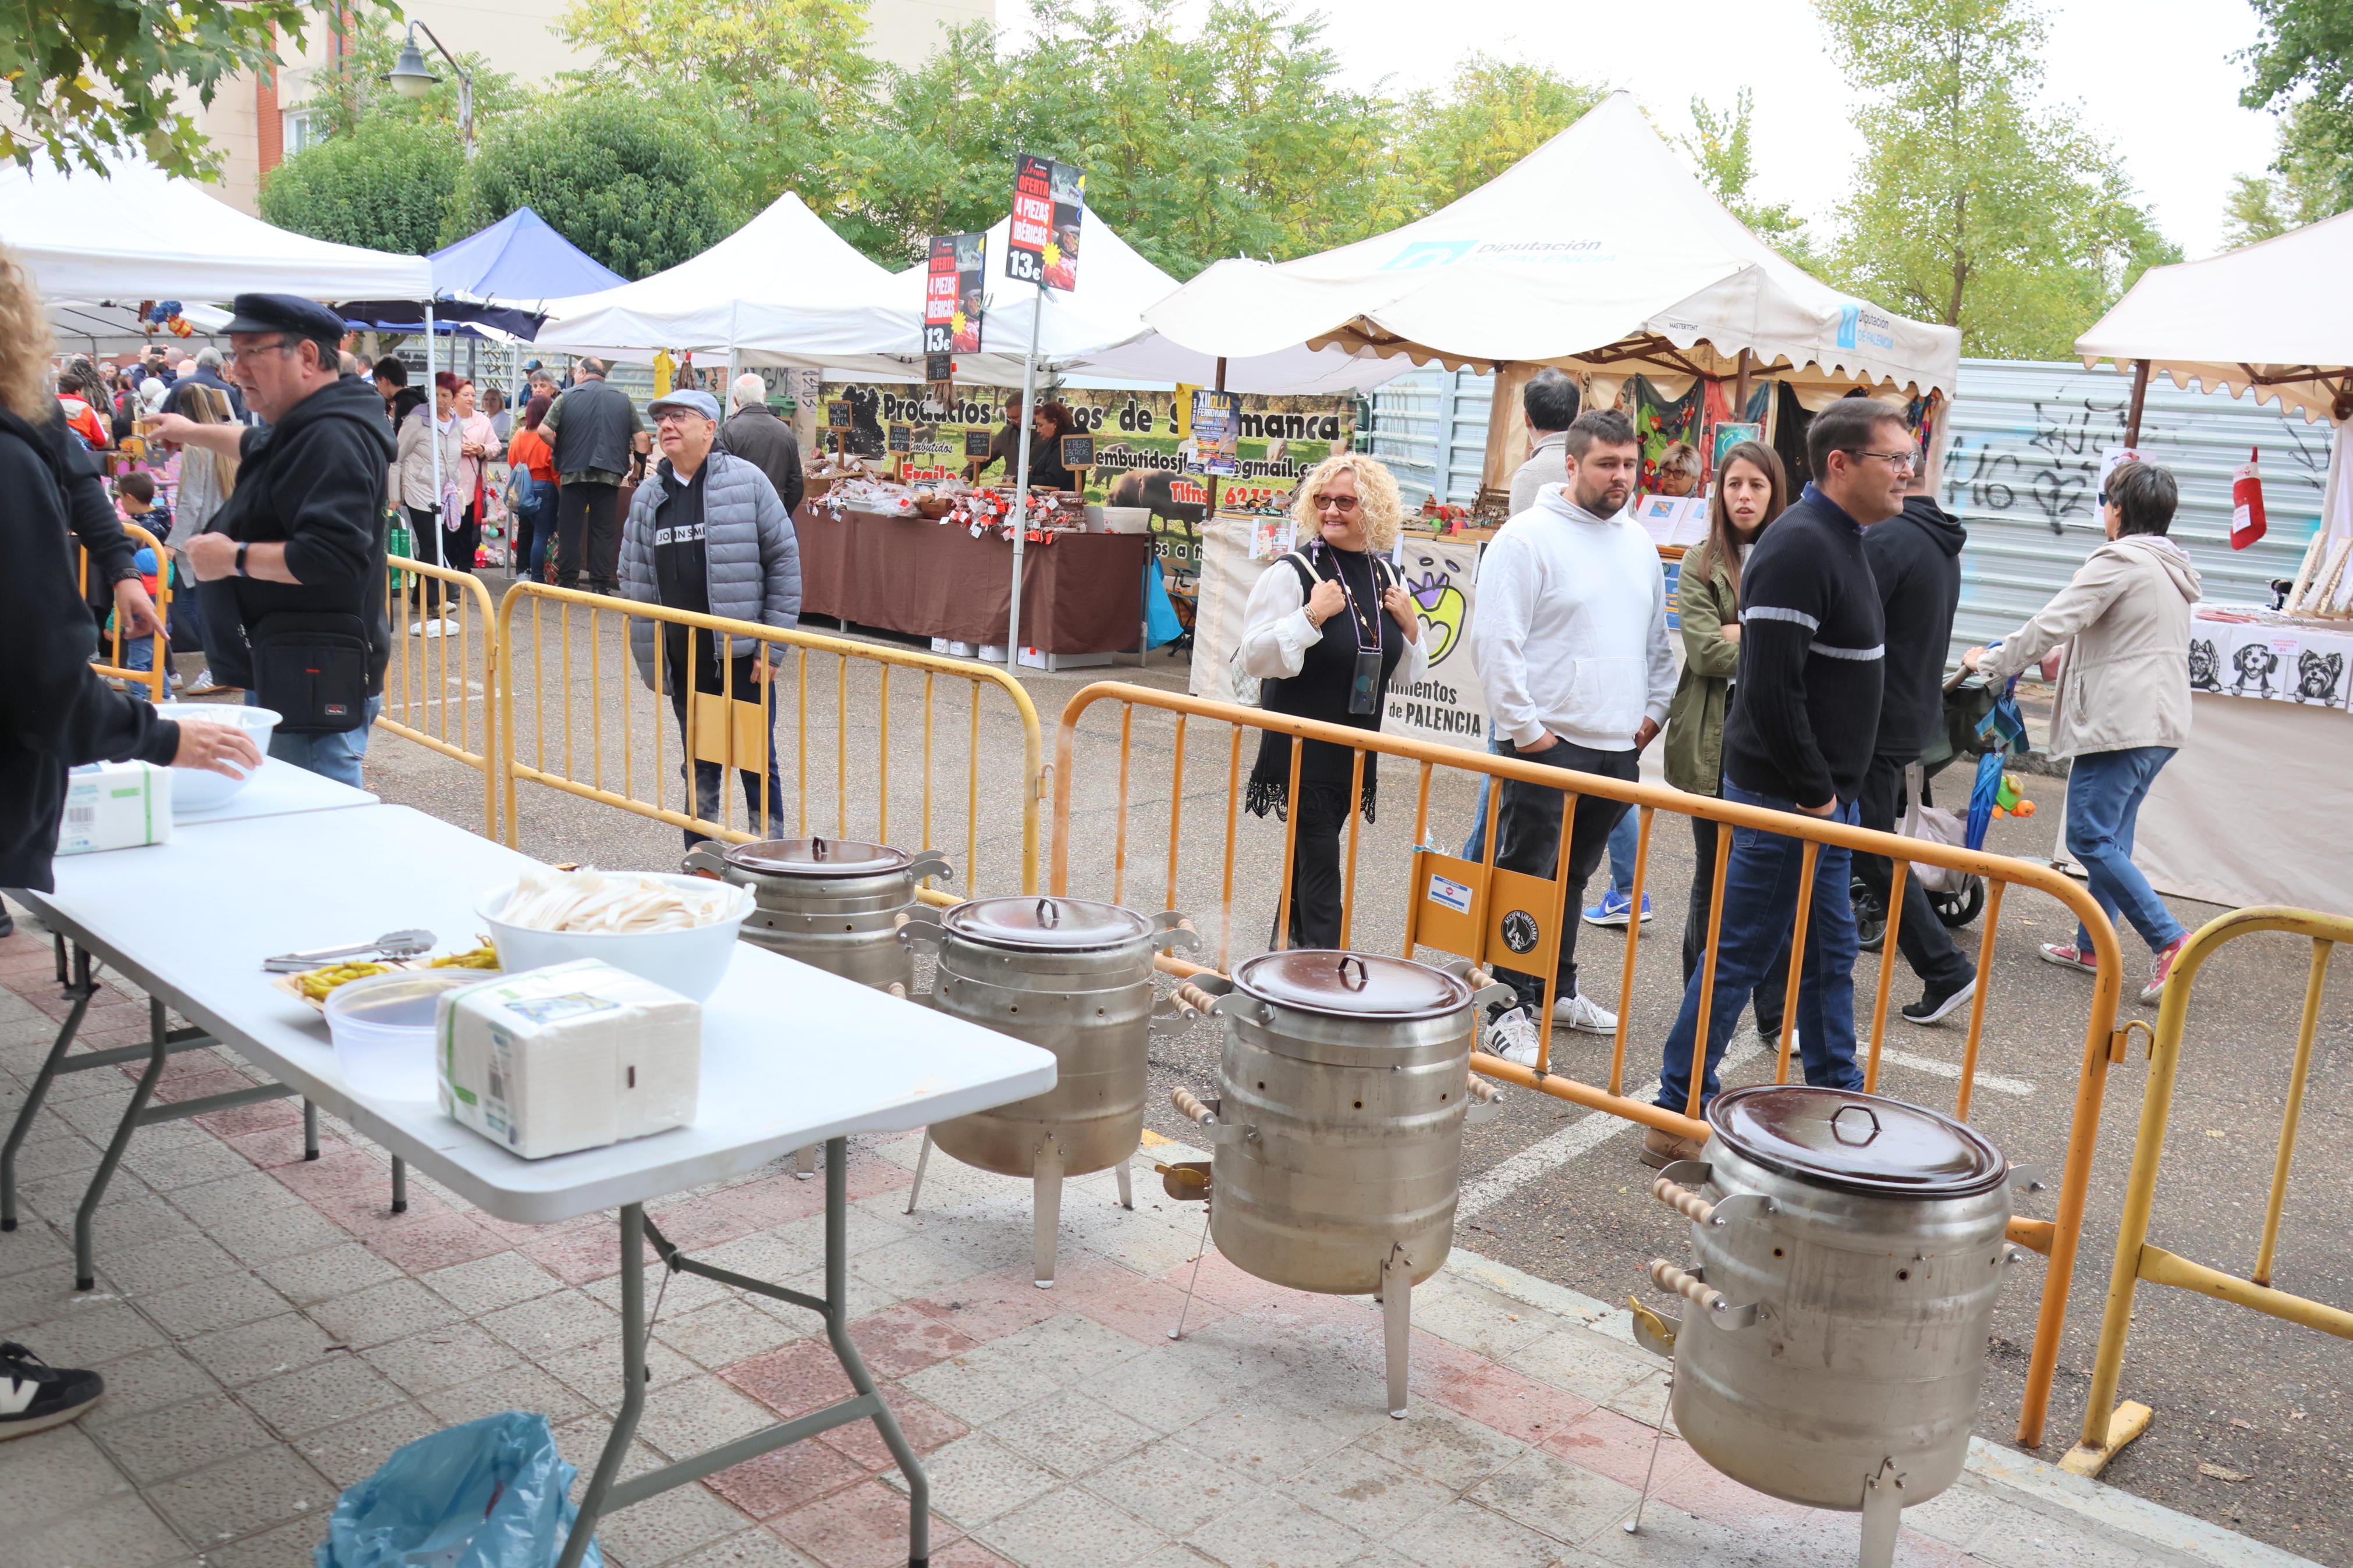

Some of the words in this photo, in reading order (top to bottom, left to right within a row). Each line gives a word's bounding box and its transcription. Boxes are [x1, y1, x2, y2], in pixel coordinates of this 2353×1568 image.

[1018, 175, 1049, 197] OFERTA
[1016, 196, 1023, 215] 4
[1023, 198, 1050, 222] PIEZAS
[1013, 219, 1048, 246] IBÉRICAS
[1477, 240, 1602, 253] Diputación
[930, 256, 955, 271] OFERTA
[1497, 254, 1618, 264] PALENCIA
[929, 278, 934, 295] 4
[935, 276, 956, 295] PIEZAS
[928, 297, 954, 318] IBÉRICAS
[1669, 322, 1698, 331] MASTERTENT
[1859, 310, 1889, 330] Diputación
[1858, 329, 1865, 342] DE
[1867, 331, 1893, 350] PALENCIA
[1198, 392, 1211, 408] XII
[1211, 395, 1230, 410] OLLA
[1119, 400, 1152, 432] de
[1197, 408, 1230, 418] FERROVIARIA
[1067, 440, 1071, 448] 4
[1177, 546, 1186, 557] a
[1389, 702, 1402, 718] de
[1405, 702, 1481, 738] PALENCIA
[1521, 913, 1537, 940] LIBERTARIA
